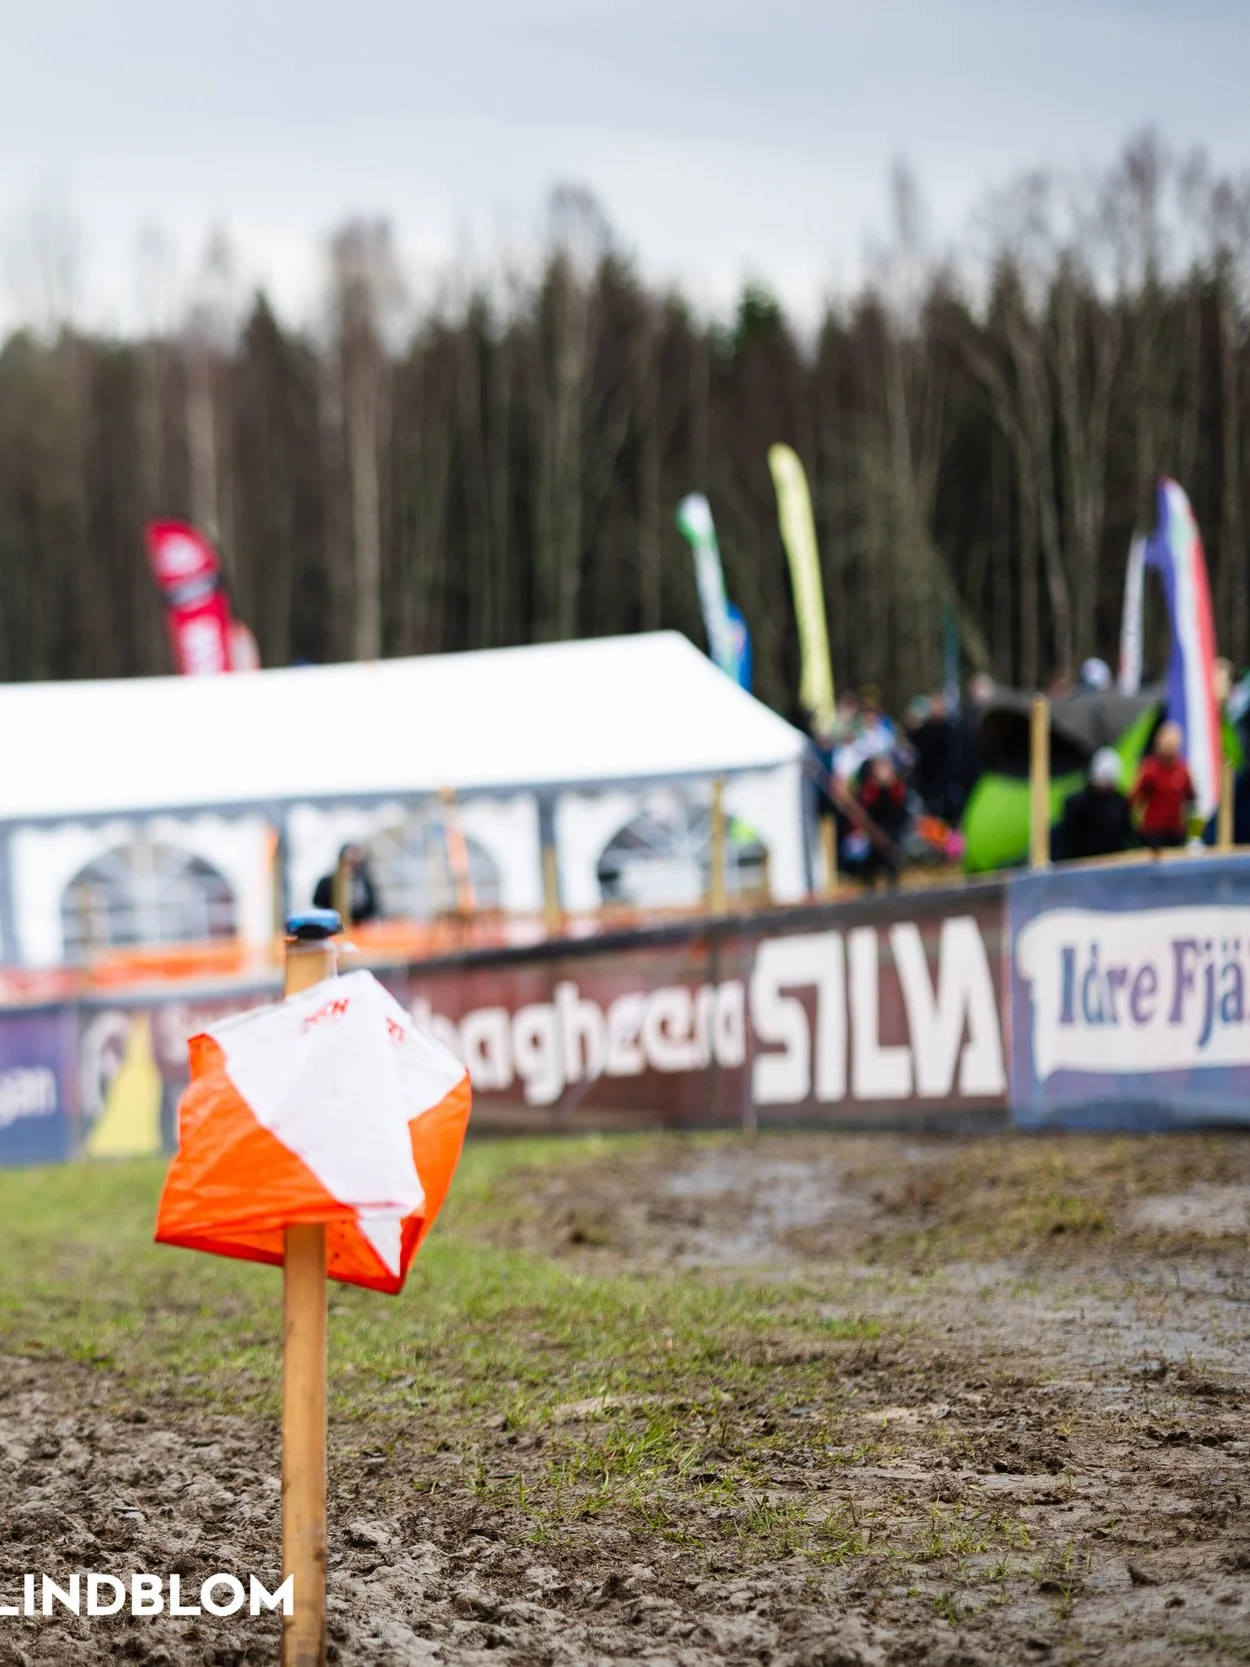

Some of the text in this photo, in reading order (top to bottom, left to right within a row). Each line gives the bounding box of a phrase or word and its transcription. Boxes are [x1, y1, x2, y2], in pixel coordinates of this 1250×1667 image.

[752, 914, 1009, 1104] SILVA
[1059, 937, 1250, 1049] Idre Fjä
